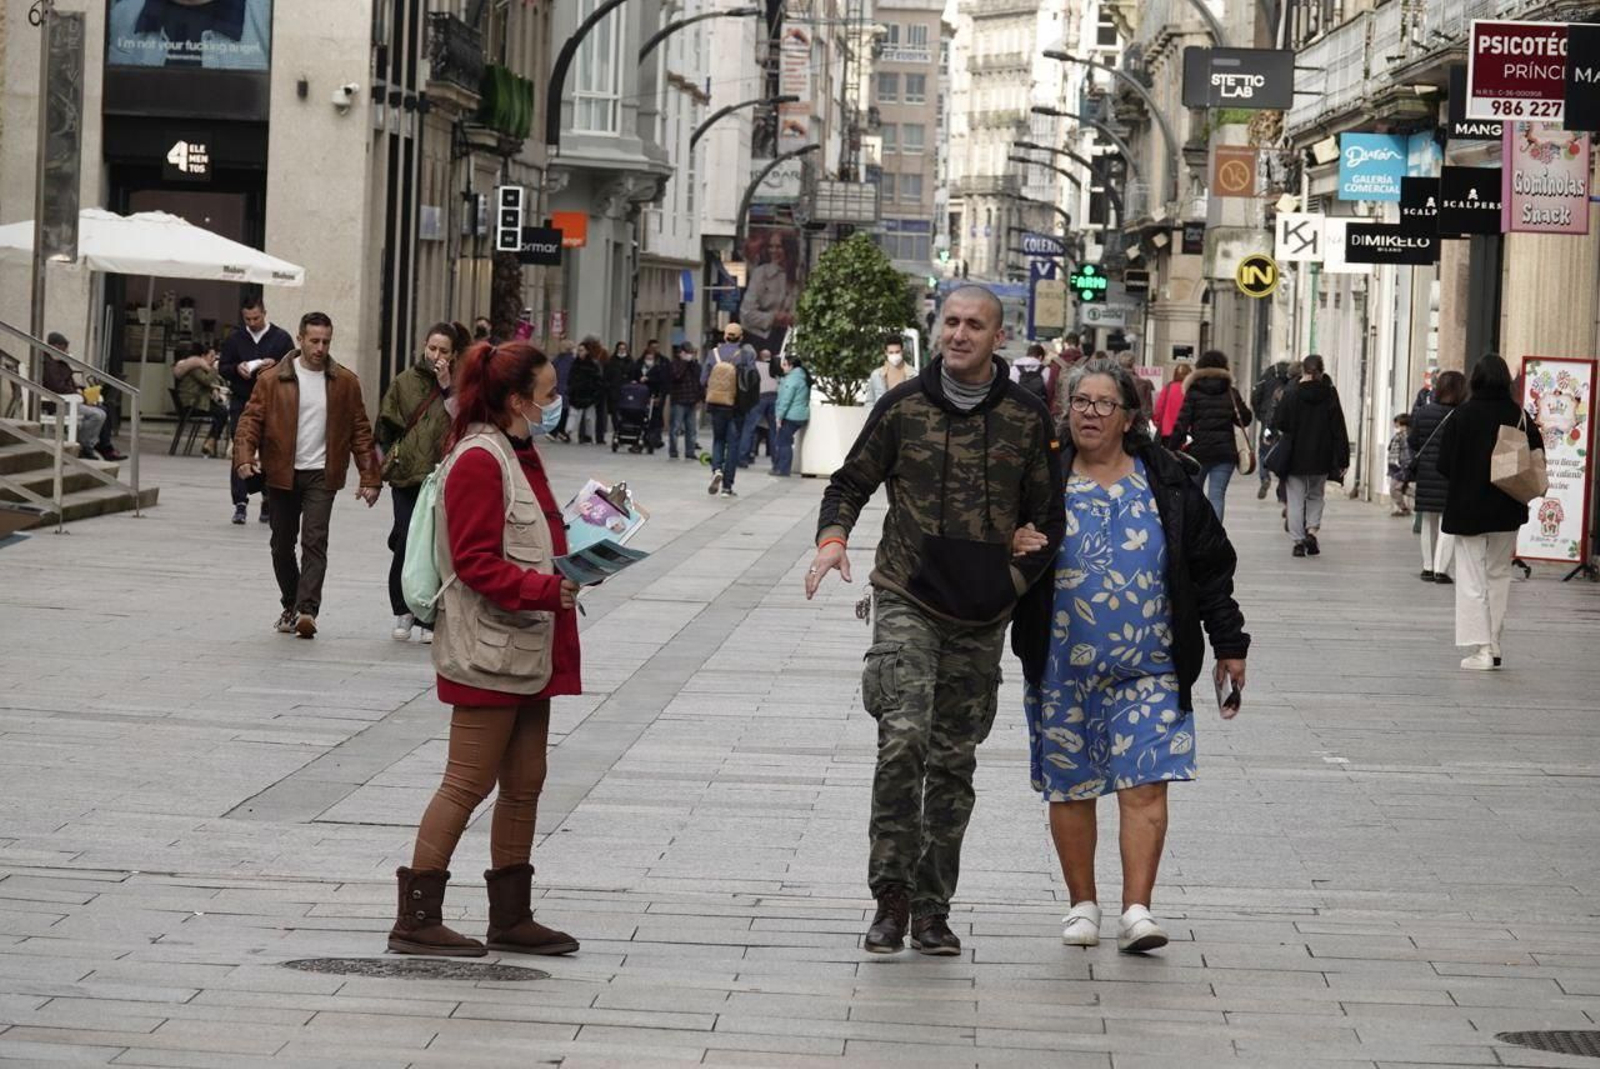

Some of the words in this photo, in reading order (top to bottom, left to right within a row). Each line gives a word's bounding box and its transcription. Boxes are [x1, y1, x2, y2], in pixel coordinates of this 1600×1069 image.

[137, 39, 156, 49] not
[158, 40, 184, 52] your
[186, 40, 227, 53] fucking
[1221, 86, 1253, 98] LAB
[1491, 100, 1524, 116] 986
[1529, 101, 1562, 117] 227
[1455, 123, 1502, 136] MANG
[167, 140, 188, 172] 4
[1352, 173, 1394, 184] GALERÍA
[1514, 167, 1586, 197] Gominolas
[1344, 183, 1400, 194] COMERCIAL
[1443, 200, 1502, 210] SCALPERS
[1403, 208, 1438, 216] SCALP
[1522, 203, 1571, 225] Snack
[1242, 265, 1274, 285] IN
